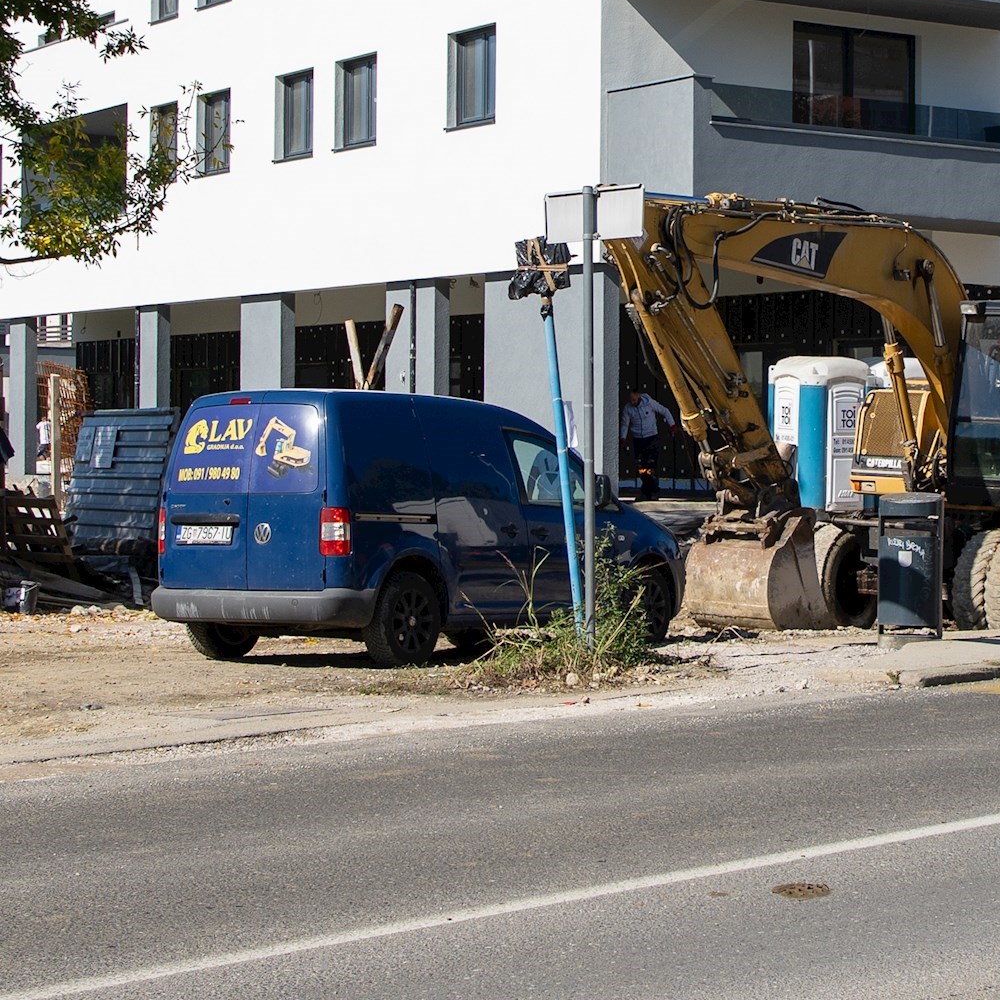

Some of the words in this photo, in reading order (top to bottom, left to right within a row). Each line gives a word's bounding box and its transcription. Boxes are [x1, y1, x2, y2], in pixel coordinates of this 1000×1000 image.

[791, 237, 819, 270] CAT
[208, 466, 222, 480] 980
[221, 466, 231, 480] 49
[230, 466, 241, 480] 80
[181, 526, 192, 540] ZG
